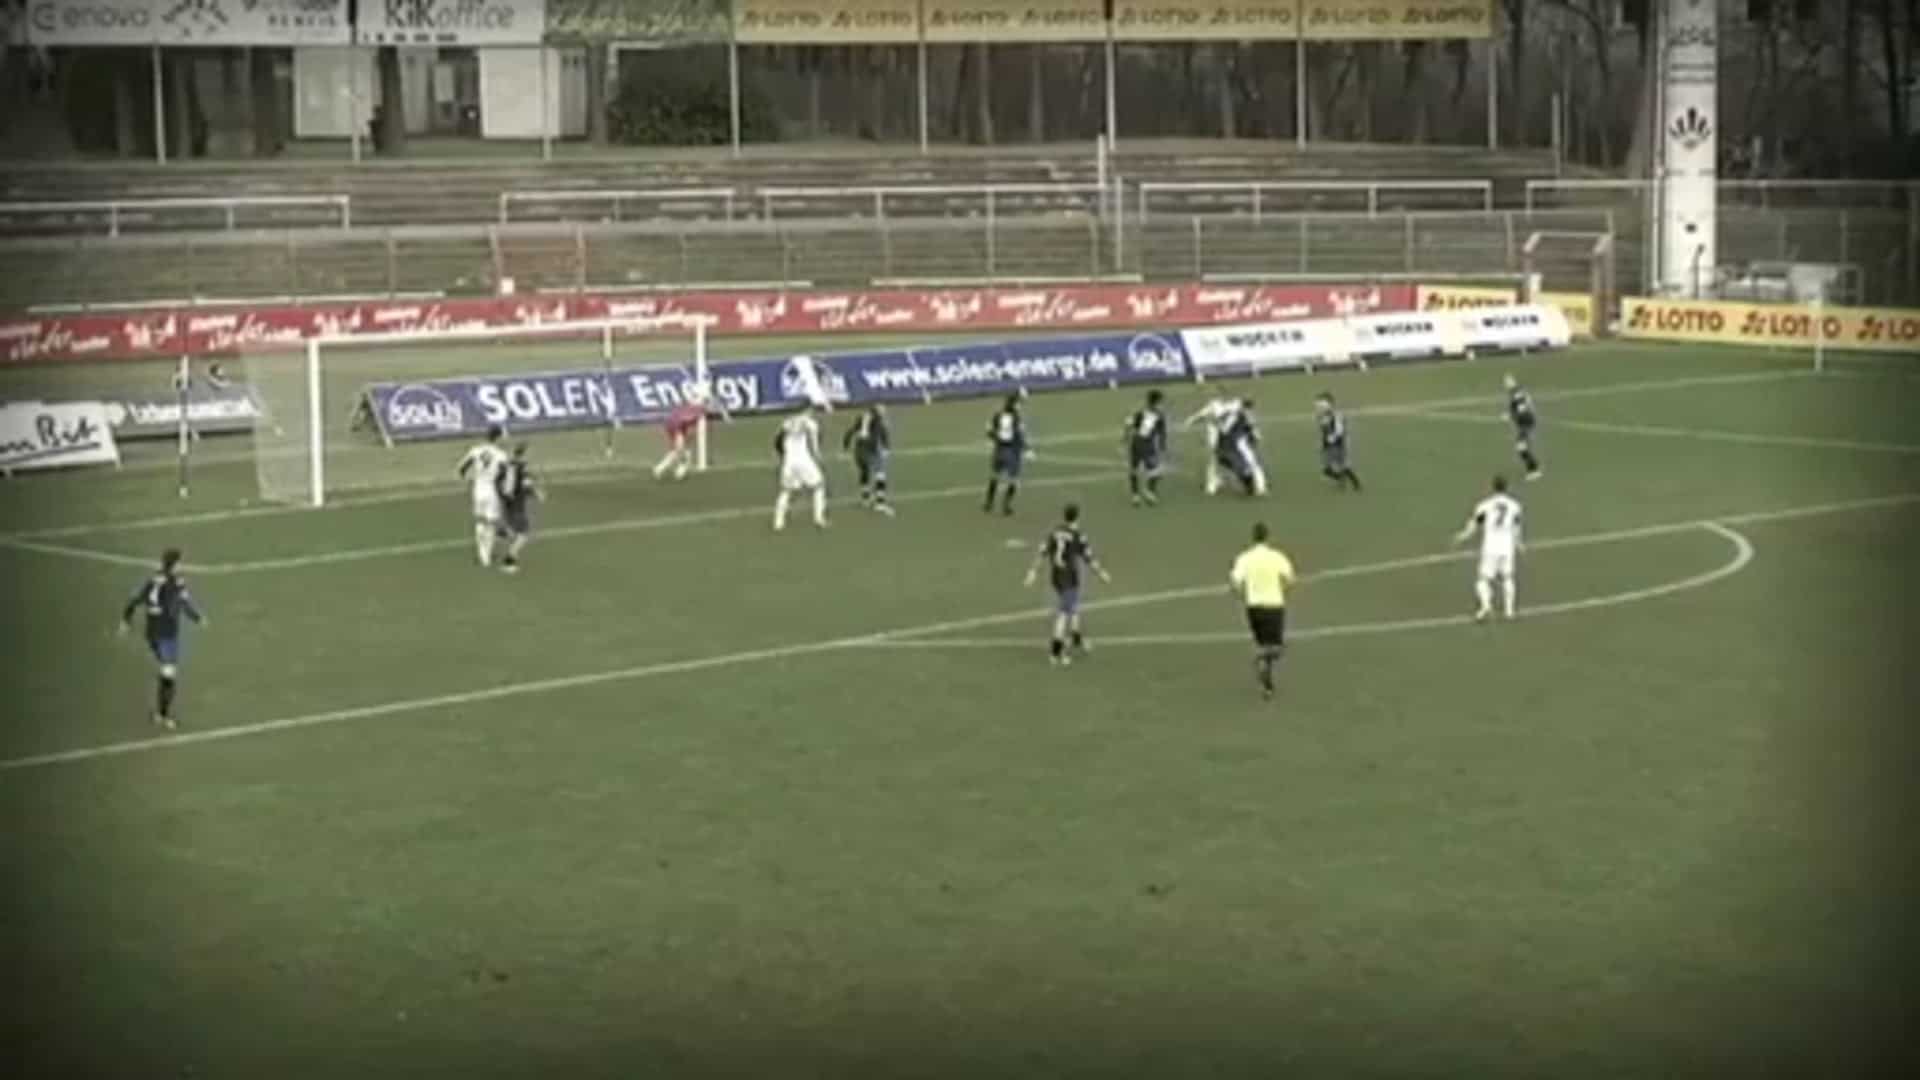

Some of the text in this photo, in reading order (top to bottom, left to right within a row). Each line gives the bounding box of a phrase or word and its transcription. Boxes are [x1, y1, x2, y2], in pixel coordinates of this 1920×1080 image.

[1656, 307, 1725, 333] LOTTO
[1769, 313, 1842, 338] LOTO
[1888, 318, 1920, 341] LO
[862, 348, 1118, 387] www.solen-energy.de
[477, 372, 759, 422] SOLEN Enegy
